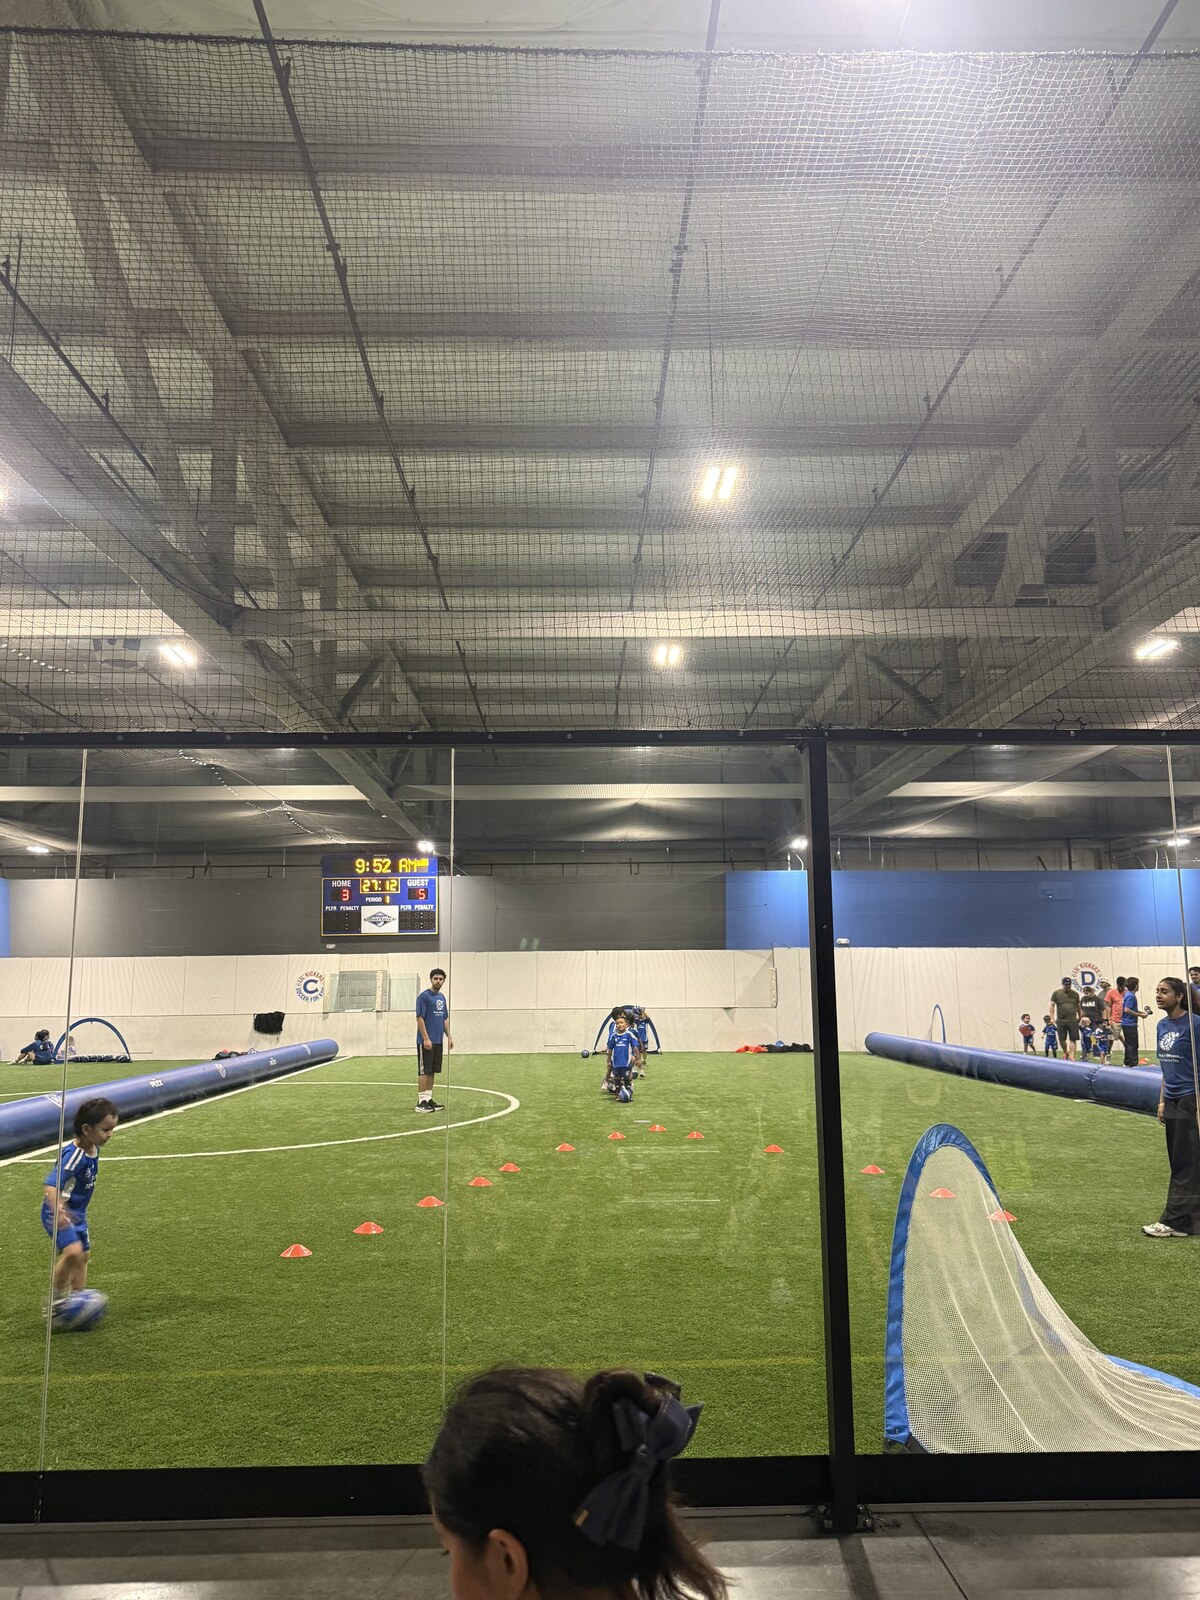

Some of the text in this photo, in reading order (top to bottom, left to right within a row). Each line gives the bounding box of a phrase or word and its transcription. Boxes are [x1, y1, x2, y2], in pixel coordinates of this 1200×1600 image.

[355, 858, 417, 873] 9:52 AM
[362, 880, 398, 892] 27:12
[407, 879, 429, 887] GUEST
[342, 889, 350, 901] 3
[418, 888, 426, 900] 5
[1081, 971, 1095, 985] D
[303, 979, 319, 994] C
